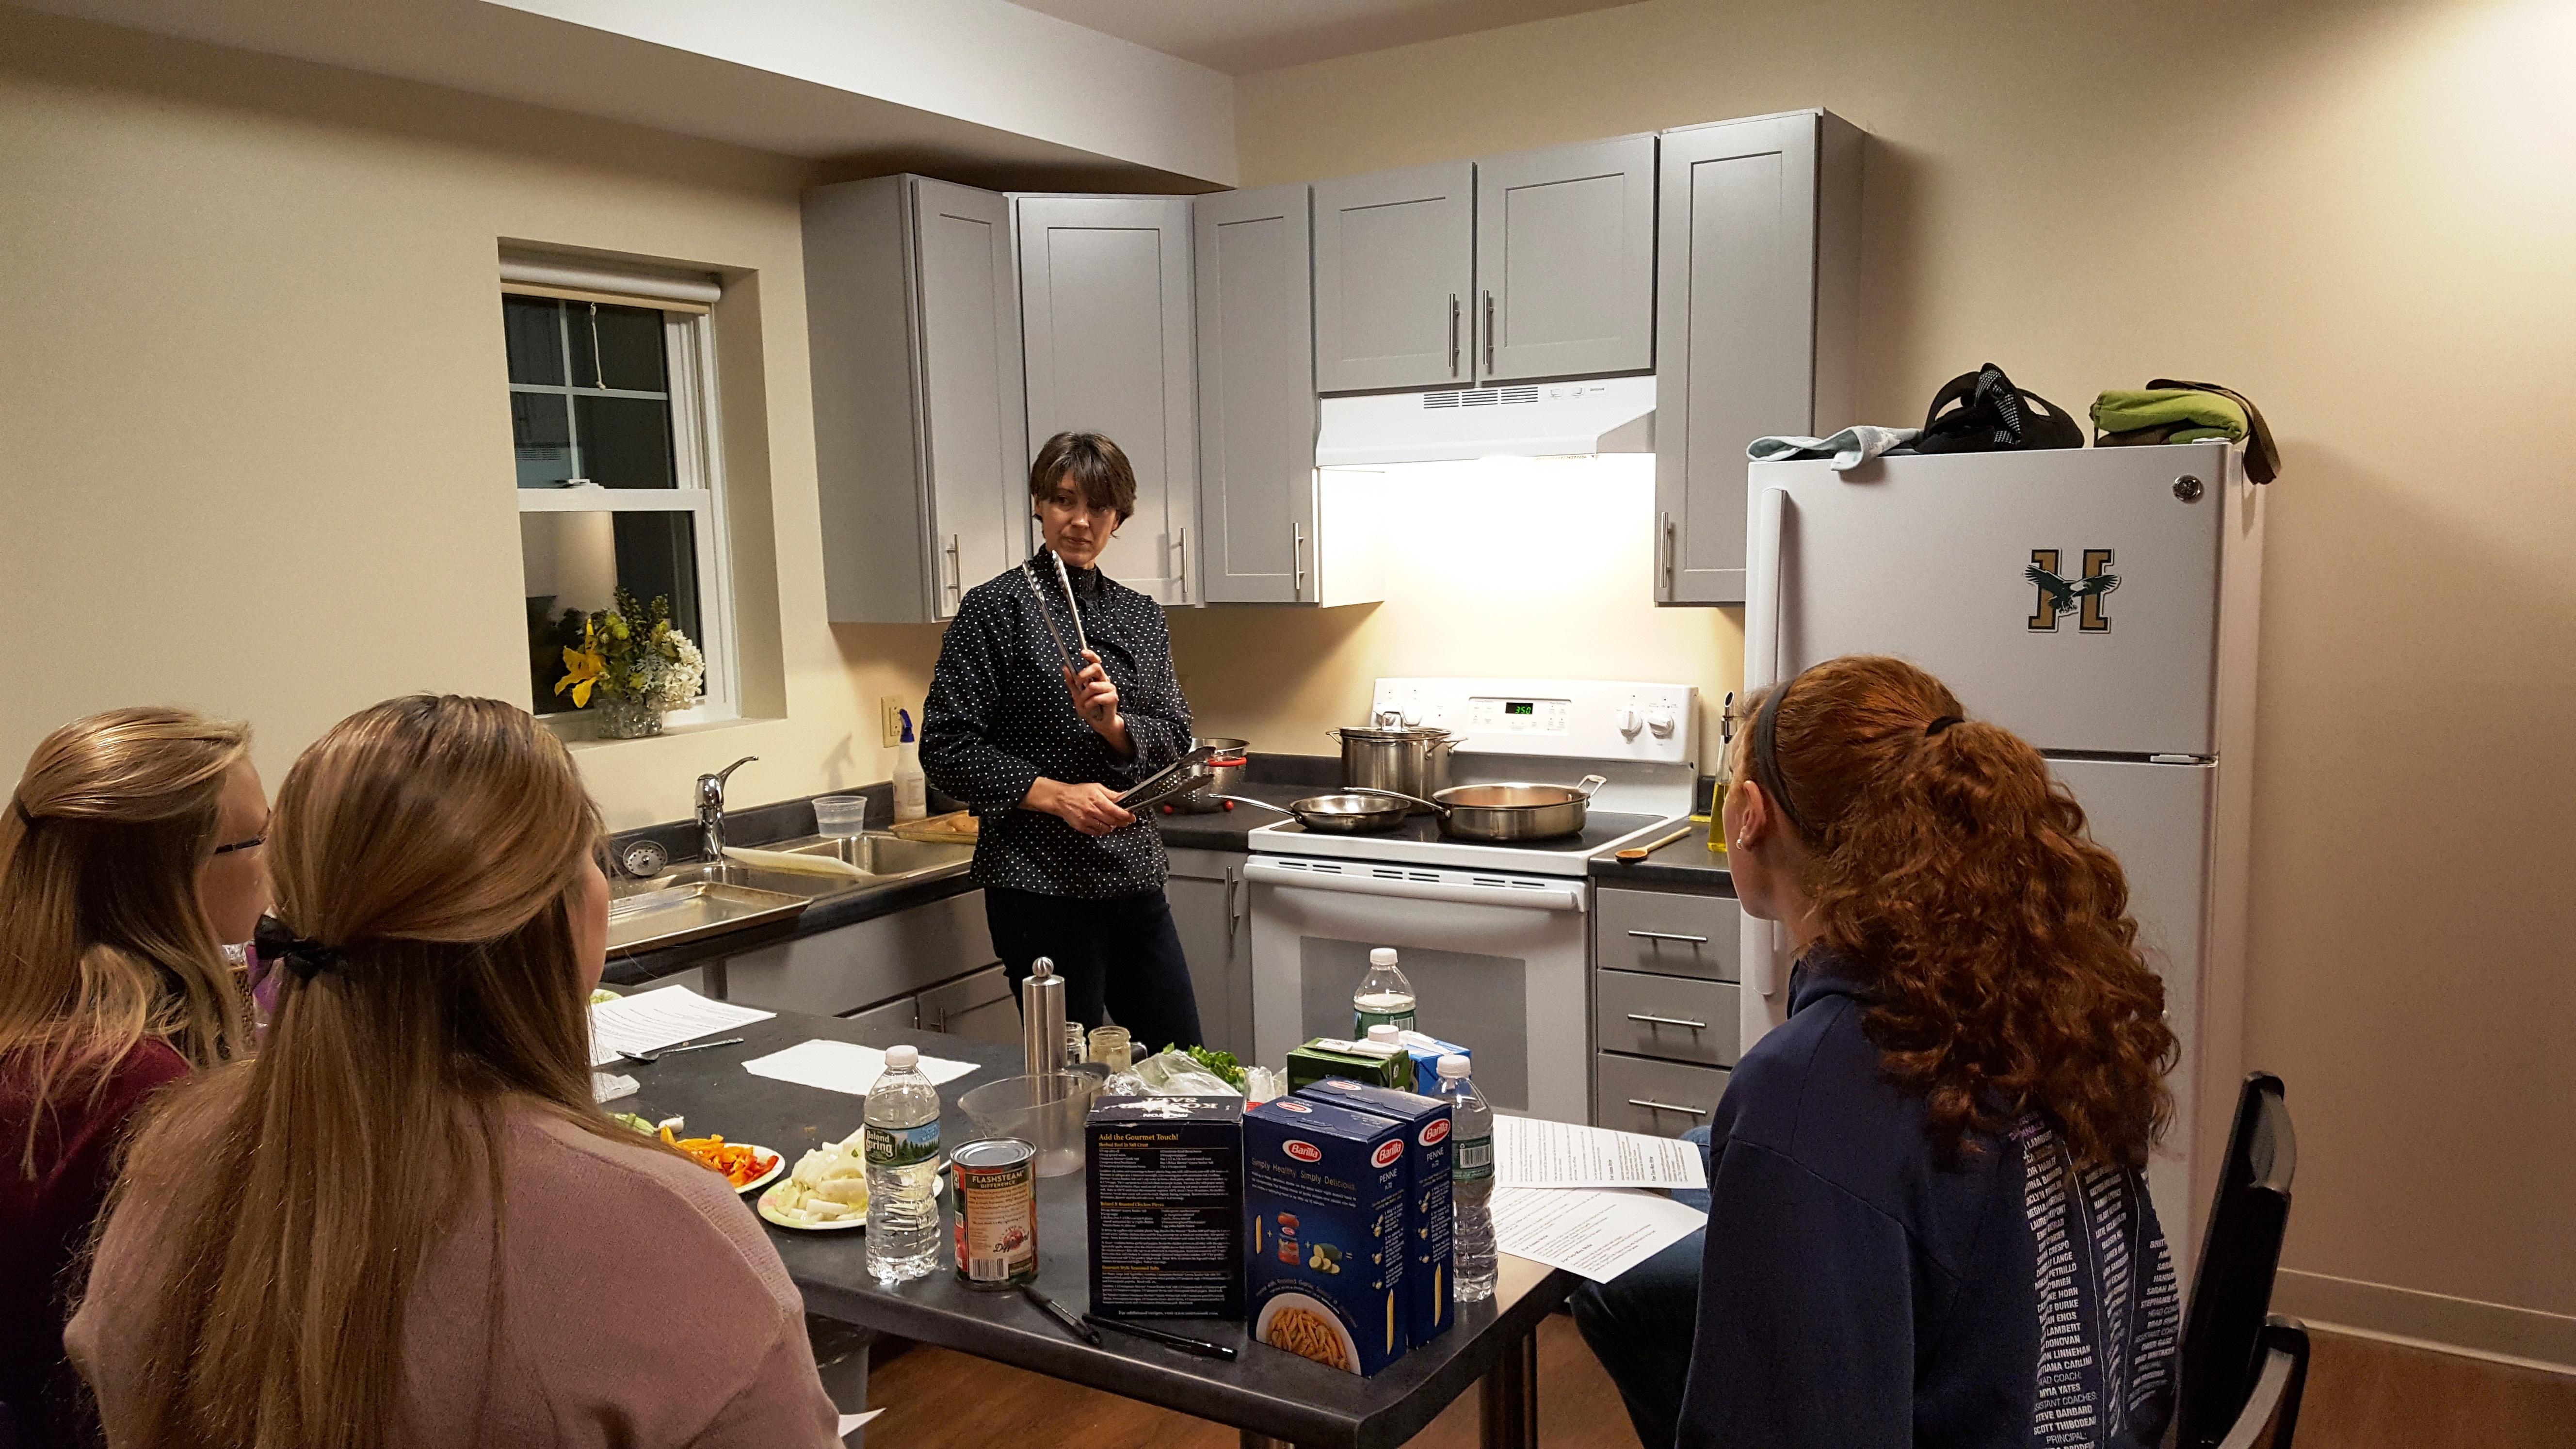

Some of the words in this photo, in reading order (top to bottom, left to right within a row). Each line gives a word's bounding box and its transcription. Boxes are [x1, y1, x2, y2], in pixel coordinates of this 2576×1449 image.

[2028, 549, 2113, 631] H
[1515, 706, 1531, 714] 350
[866, 1129, 890, 1143] Poland
[1426, 1121, 1449, 1141] Barilla
[1291, 1144, 1319, 1159] Barilla
[1379, 1142, 1401, 1162] Barilla
[1426, 1146, 1444, 1162] PENNE
[1252, 1157, 1271, 1171] Simply
[1300, 1170, 1321, 1184] Simply
[1379, 1168, 1398, 1184] PENNE
[2027, 1203, 2047, 1220] MEGHA
[2030, 1215, 2048, 1232] LAURE
[2048, 1204, 2066, 1219] UPONT
[2048, 1240, 2070, 1256] CRESPO
[2053, 1251, 2073, 1266] LANGE
[2048, 1262, 2077, 1278] PETRILLO
[2058, 1287, 2079, 1299] HORN
[2054, 1299, 2079, 1311] BURKE
[2056, 1311, 2077, 1322] ENOS
[2046, 1322, 2081, 1337] LAMBERT
[2045, 1335, 2081, 1349] DONOVAN
[2053, 1344, 2092, 1359] LINNEHAN
[2063, 1355, 2093, 1370] CARLINI
[2058, 1383, 2081, 1395] YATES
[2035, 1410, 2056, 1423] STEVE
[2055, 1404, 2093, 1419] BARBARO
[2033, 1423, 2054, 1435] SCOTT
